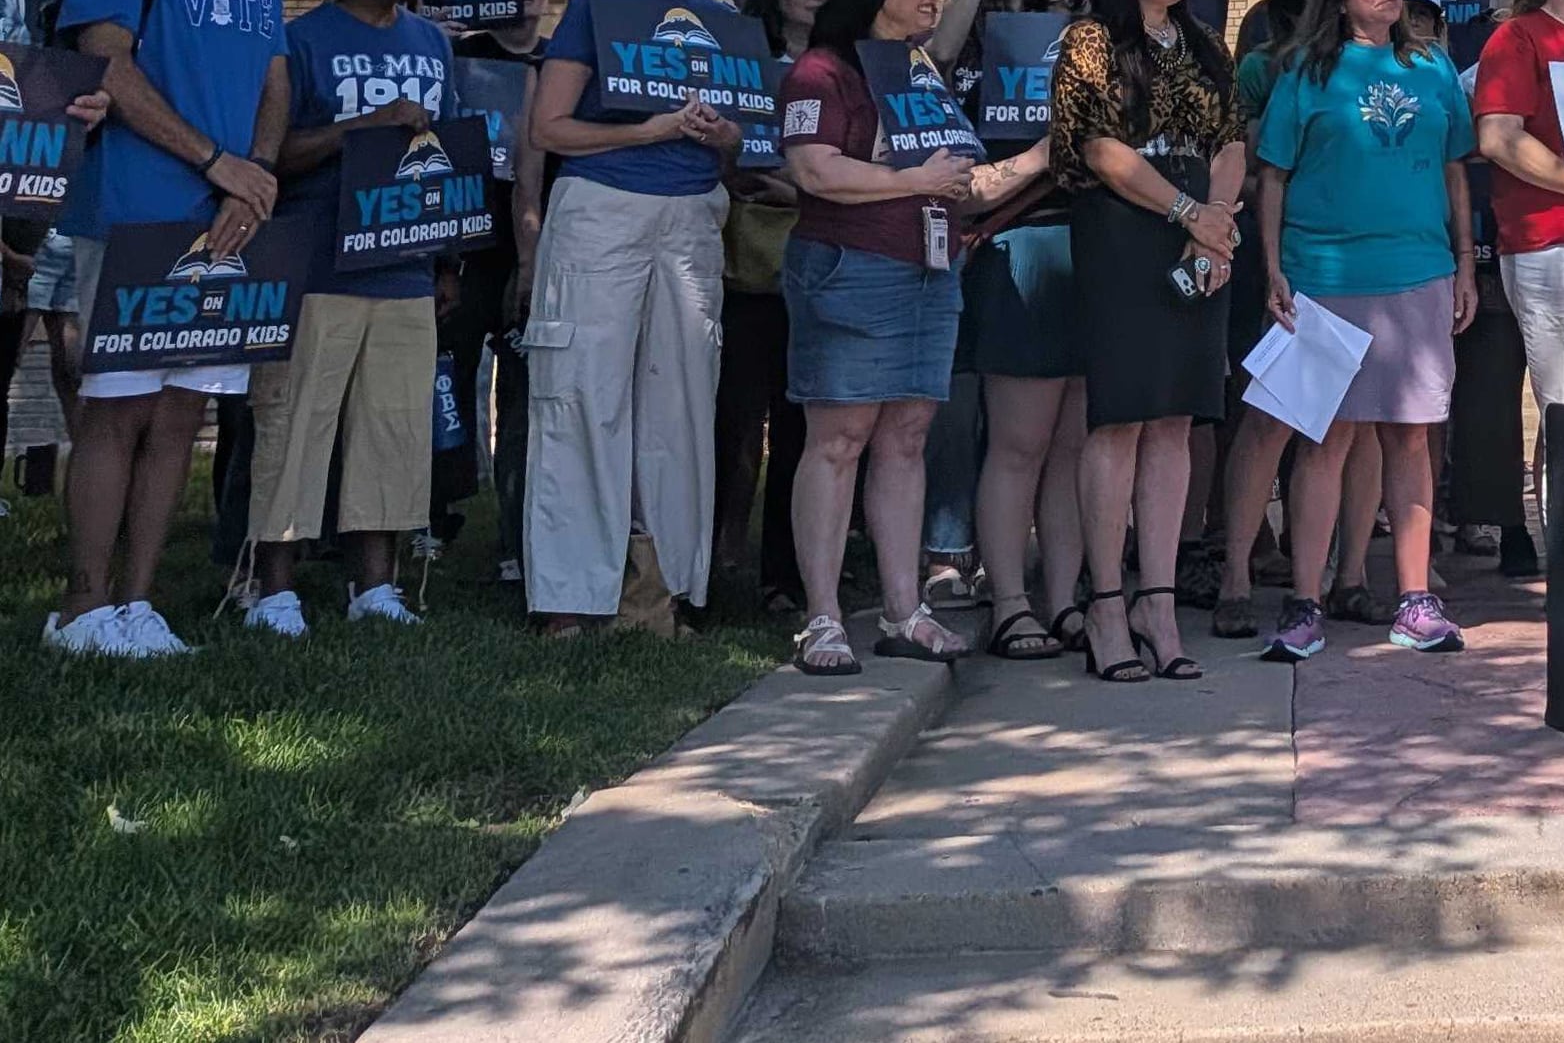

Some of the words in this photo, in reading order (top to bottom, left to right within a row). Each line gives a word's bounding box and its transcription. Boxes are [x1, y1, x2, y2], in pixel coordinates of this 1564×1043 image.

[479, 1, 518, 18] KIDS
[611, 40, 687, 80] YES
[691, 60, 708, 73] ON
[711, 54, 763, 90] NN
[333, 76, 443, 123] 1914
[607, 76, 641, 95] FOR
[738, 92, 775, 111] KIDS
[998, 66, 1050, 101] YE
[885, 92, 946, 128] YES
[985, 106, 1019, 122] FOR
[742, 139, 774, 153] FOR
[891, 133, 919, 152] FOR
[17, 174, 68, 198] KIDS
[356, 183, 422, 226] YES
[425, 190, 441, 205] ON
[441, 175, 484, 216] NN
[342, 230, 375, 252] FOR
[380, 223, 458, 247] COLORADO
[462, 214, 493, 235] KIDS
[115, 285, 200, 327] YES
[203, 294, 223, 310] ON
[226, 281, 288, 322] NN
[92, 333, 133, 354] FOR
[139, 327, 240, 352] COLORADO
[245, 324, 290, 345] KIDS
